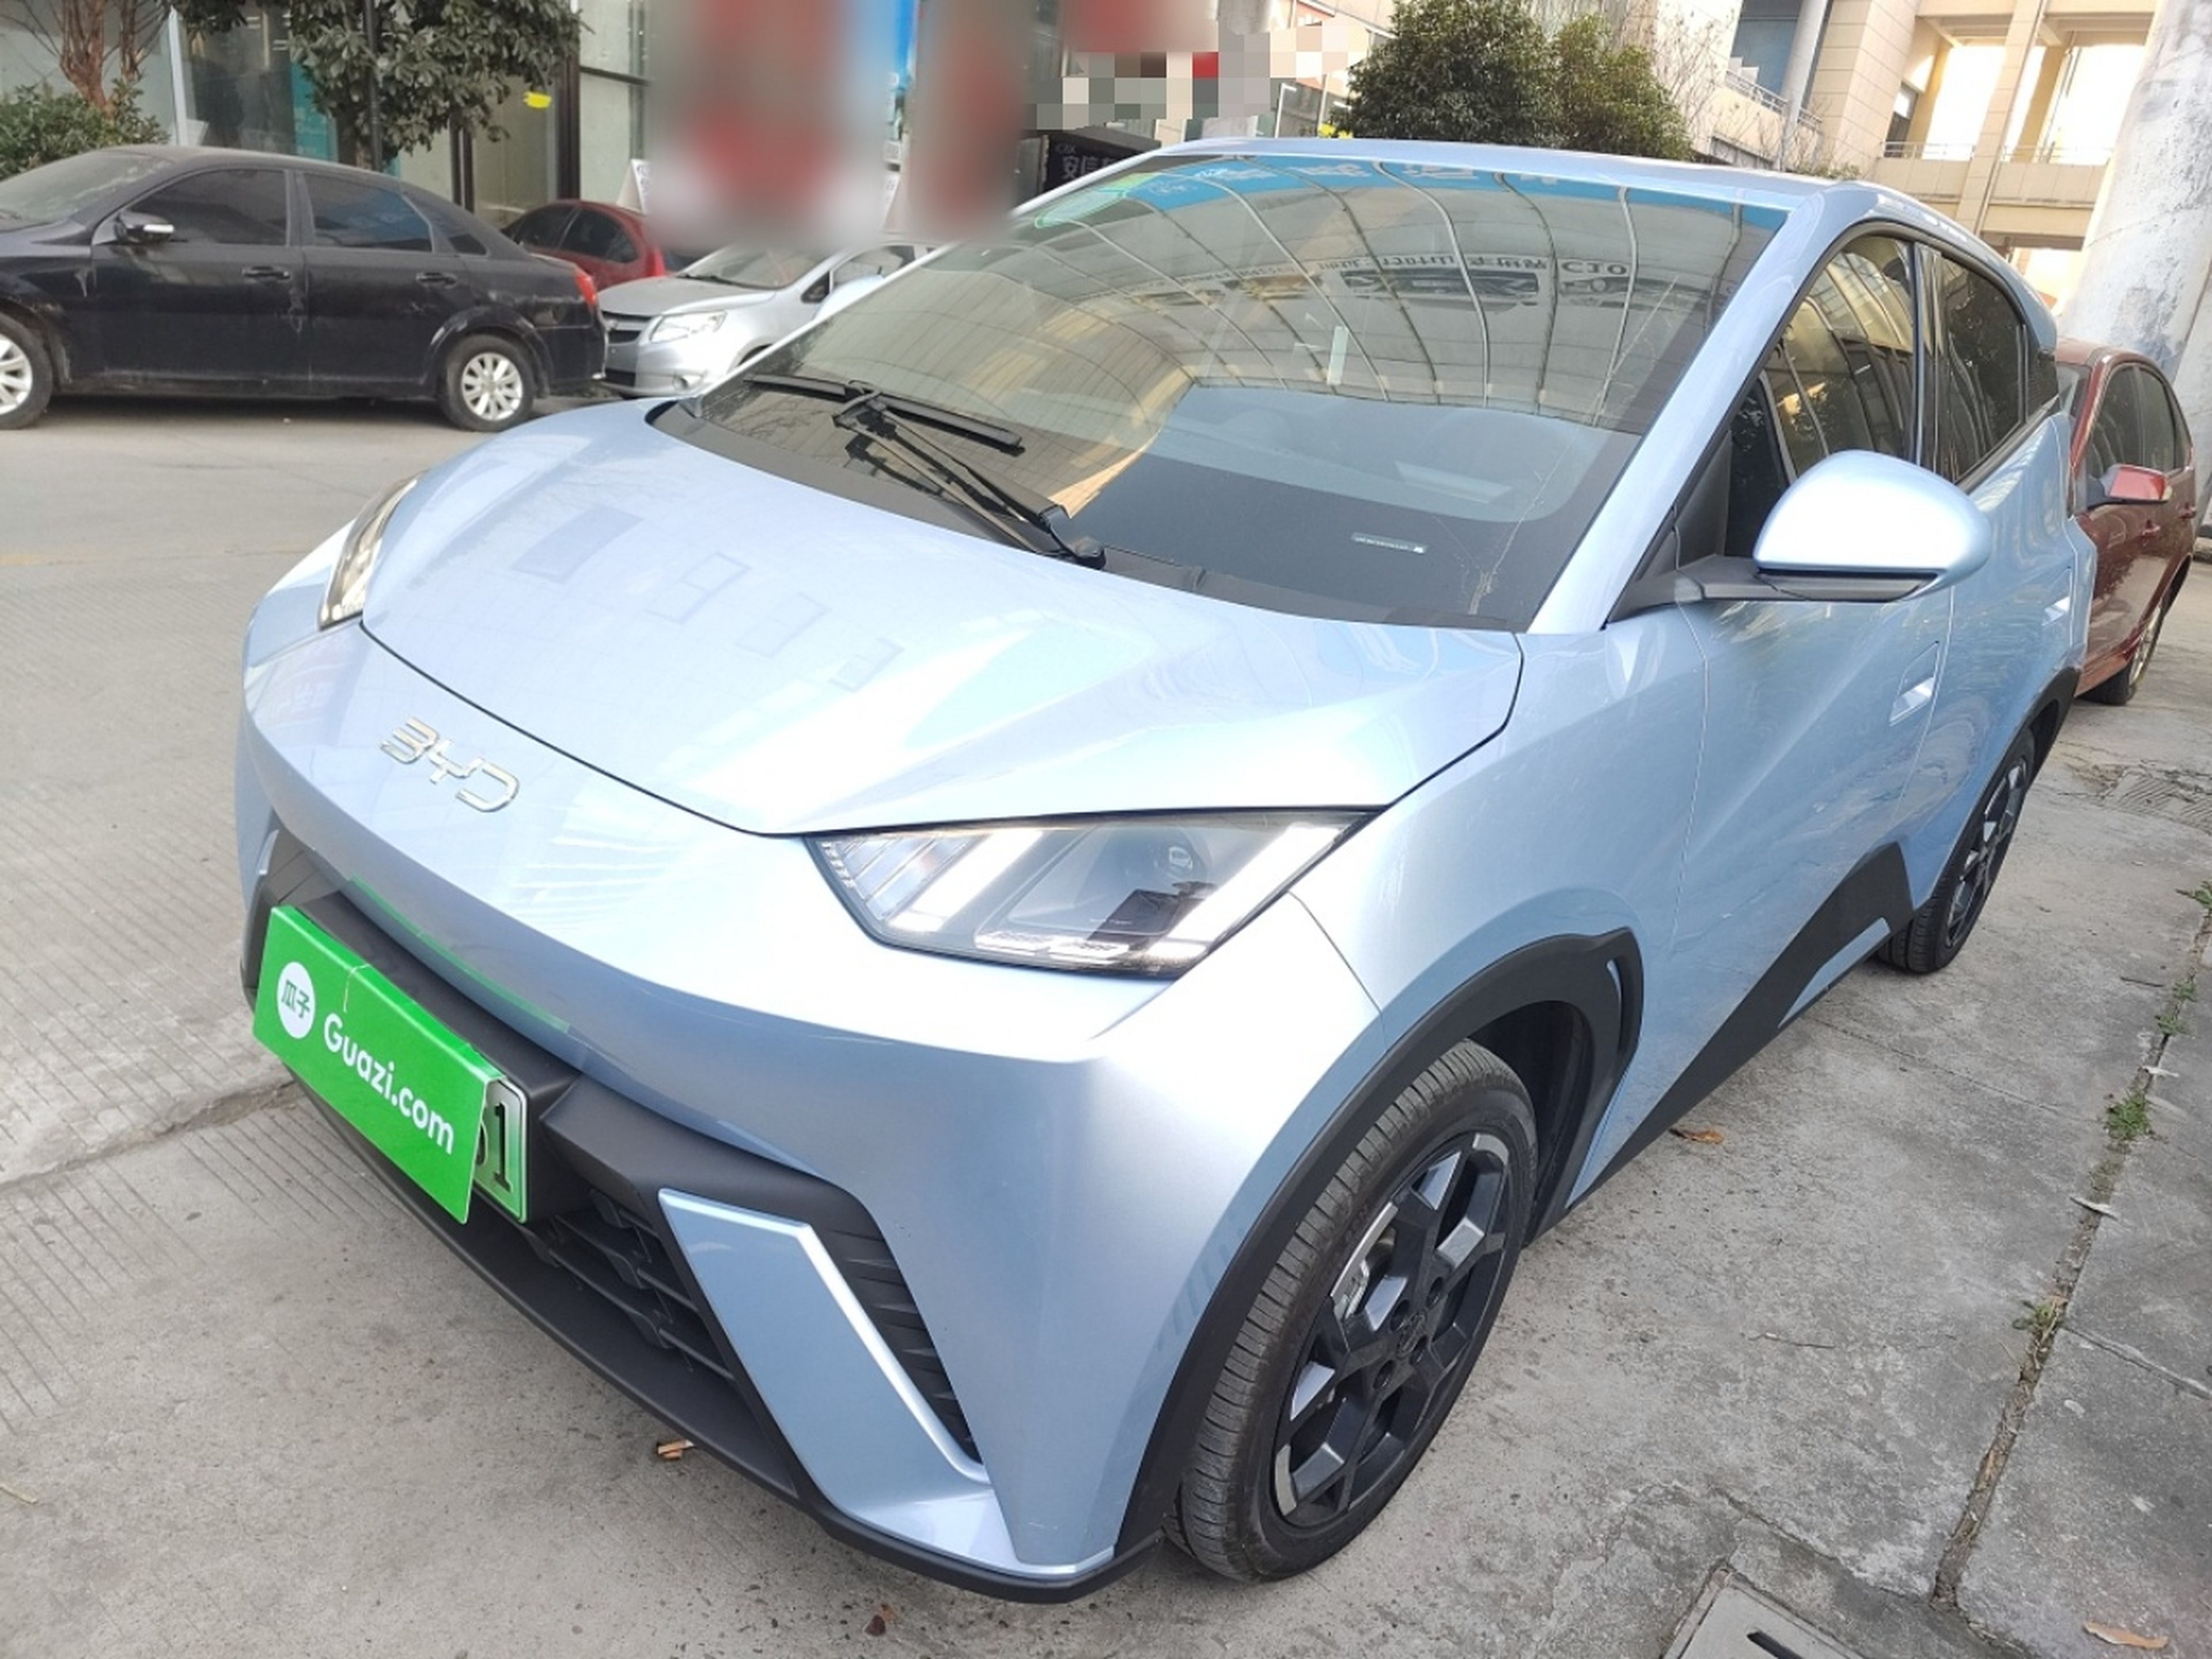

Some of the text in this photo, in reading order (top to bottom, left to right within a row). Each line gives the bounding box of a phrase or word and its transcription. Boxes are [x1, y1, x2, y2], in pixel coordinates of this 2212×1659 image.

[380, 717, 520, 813] BYD
[281, 979, 310, 1019] 瓜子
[324, 1012, 455, 1156] Guazi.com
